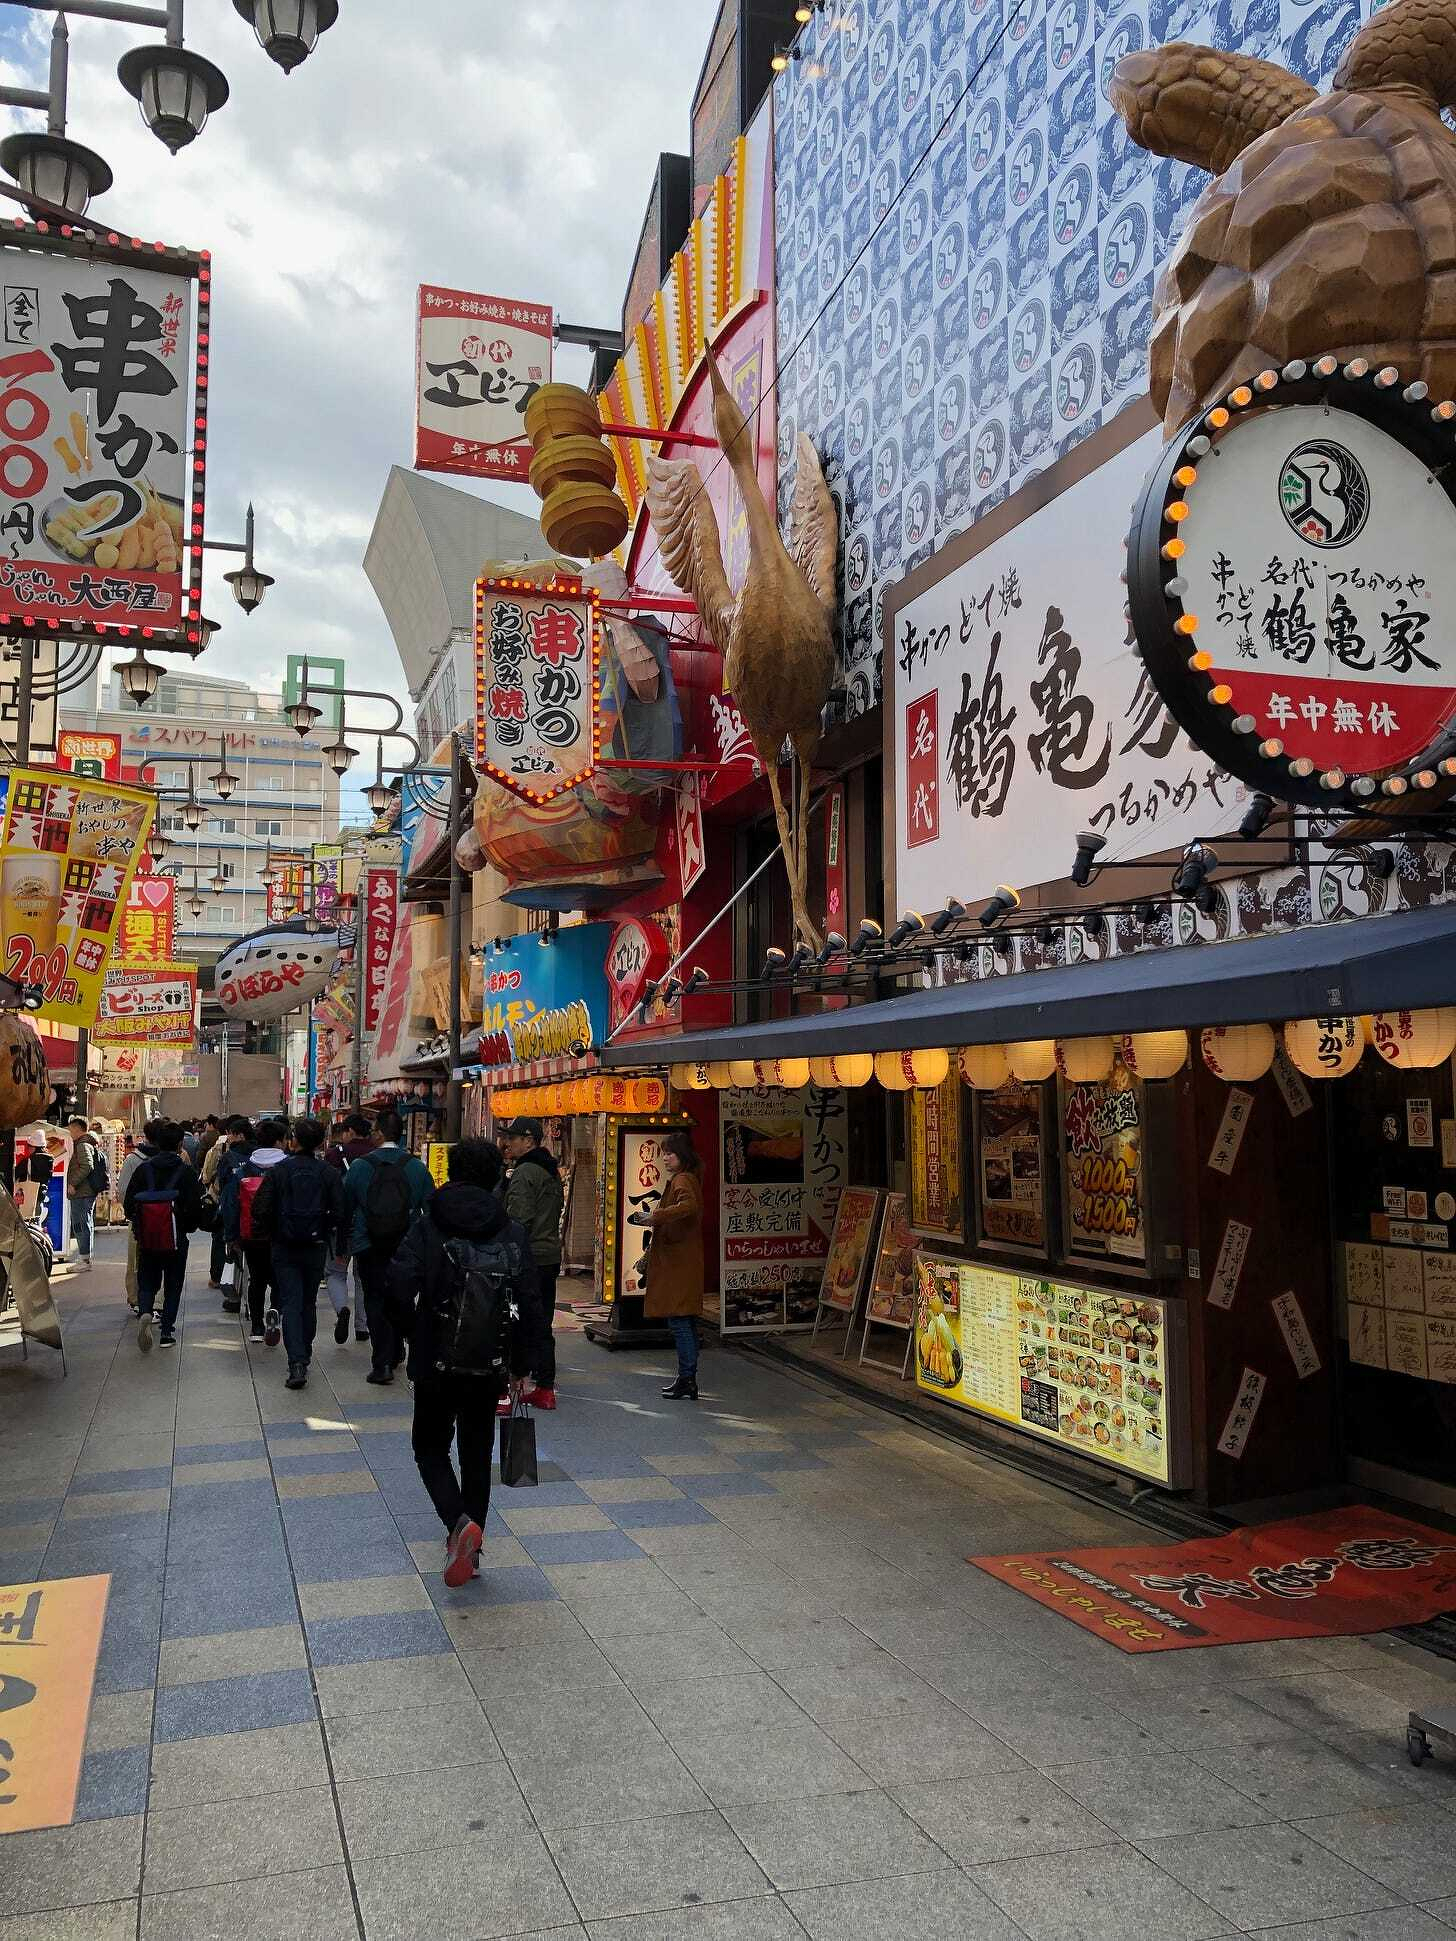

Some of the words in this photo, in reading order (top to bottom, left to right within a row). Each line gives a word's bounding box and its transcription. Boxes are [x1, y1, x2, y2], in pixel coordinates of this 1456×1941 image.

[10, 290, 37, 342] 全て
[158, 292, 184, 357] 新世界
[50, 277, 179, 538] 串かつ
[1210, 550, 1236, 629] 串かつ
[1260, 555, 1319, 590] 名代
[1327, 565, 1426, 599] つるかめや
[1235, 583, 1258, 660] どて焼
[1260, 586, 1443, 675] 鶴亀家
[490, 603, 528, 746] お好み焼き
[528, 605, 582, 747] 串かつ
[1264, 691, 1401, 737] 年中無休
[510, 754, 557, 774] エビス
[909, 708, 937, 831] 名代
